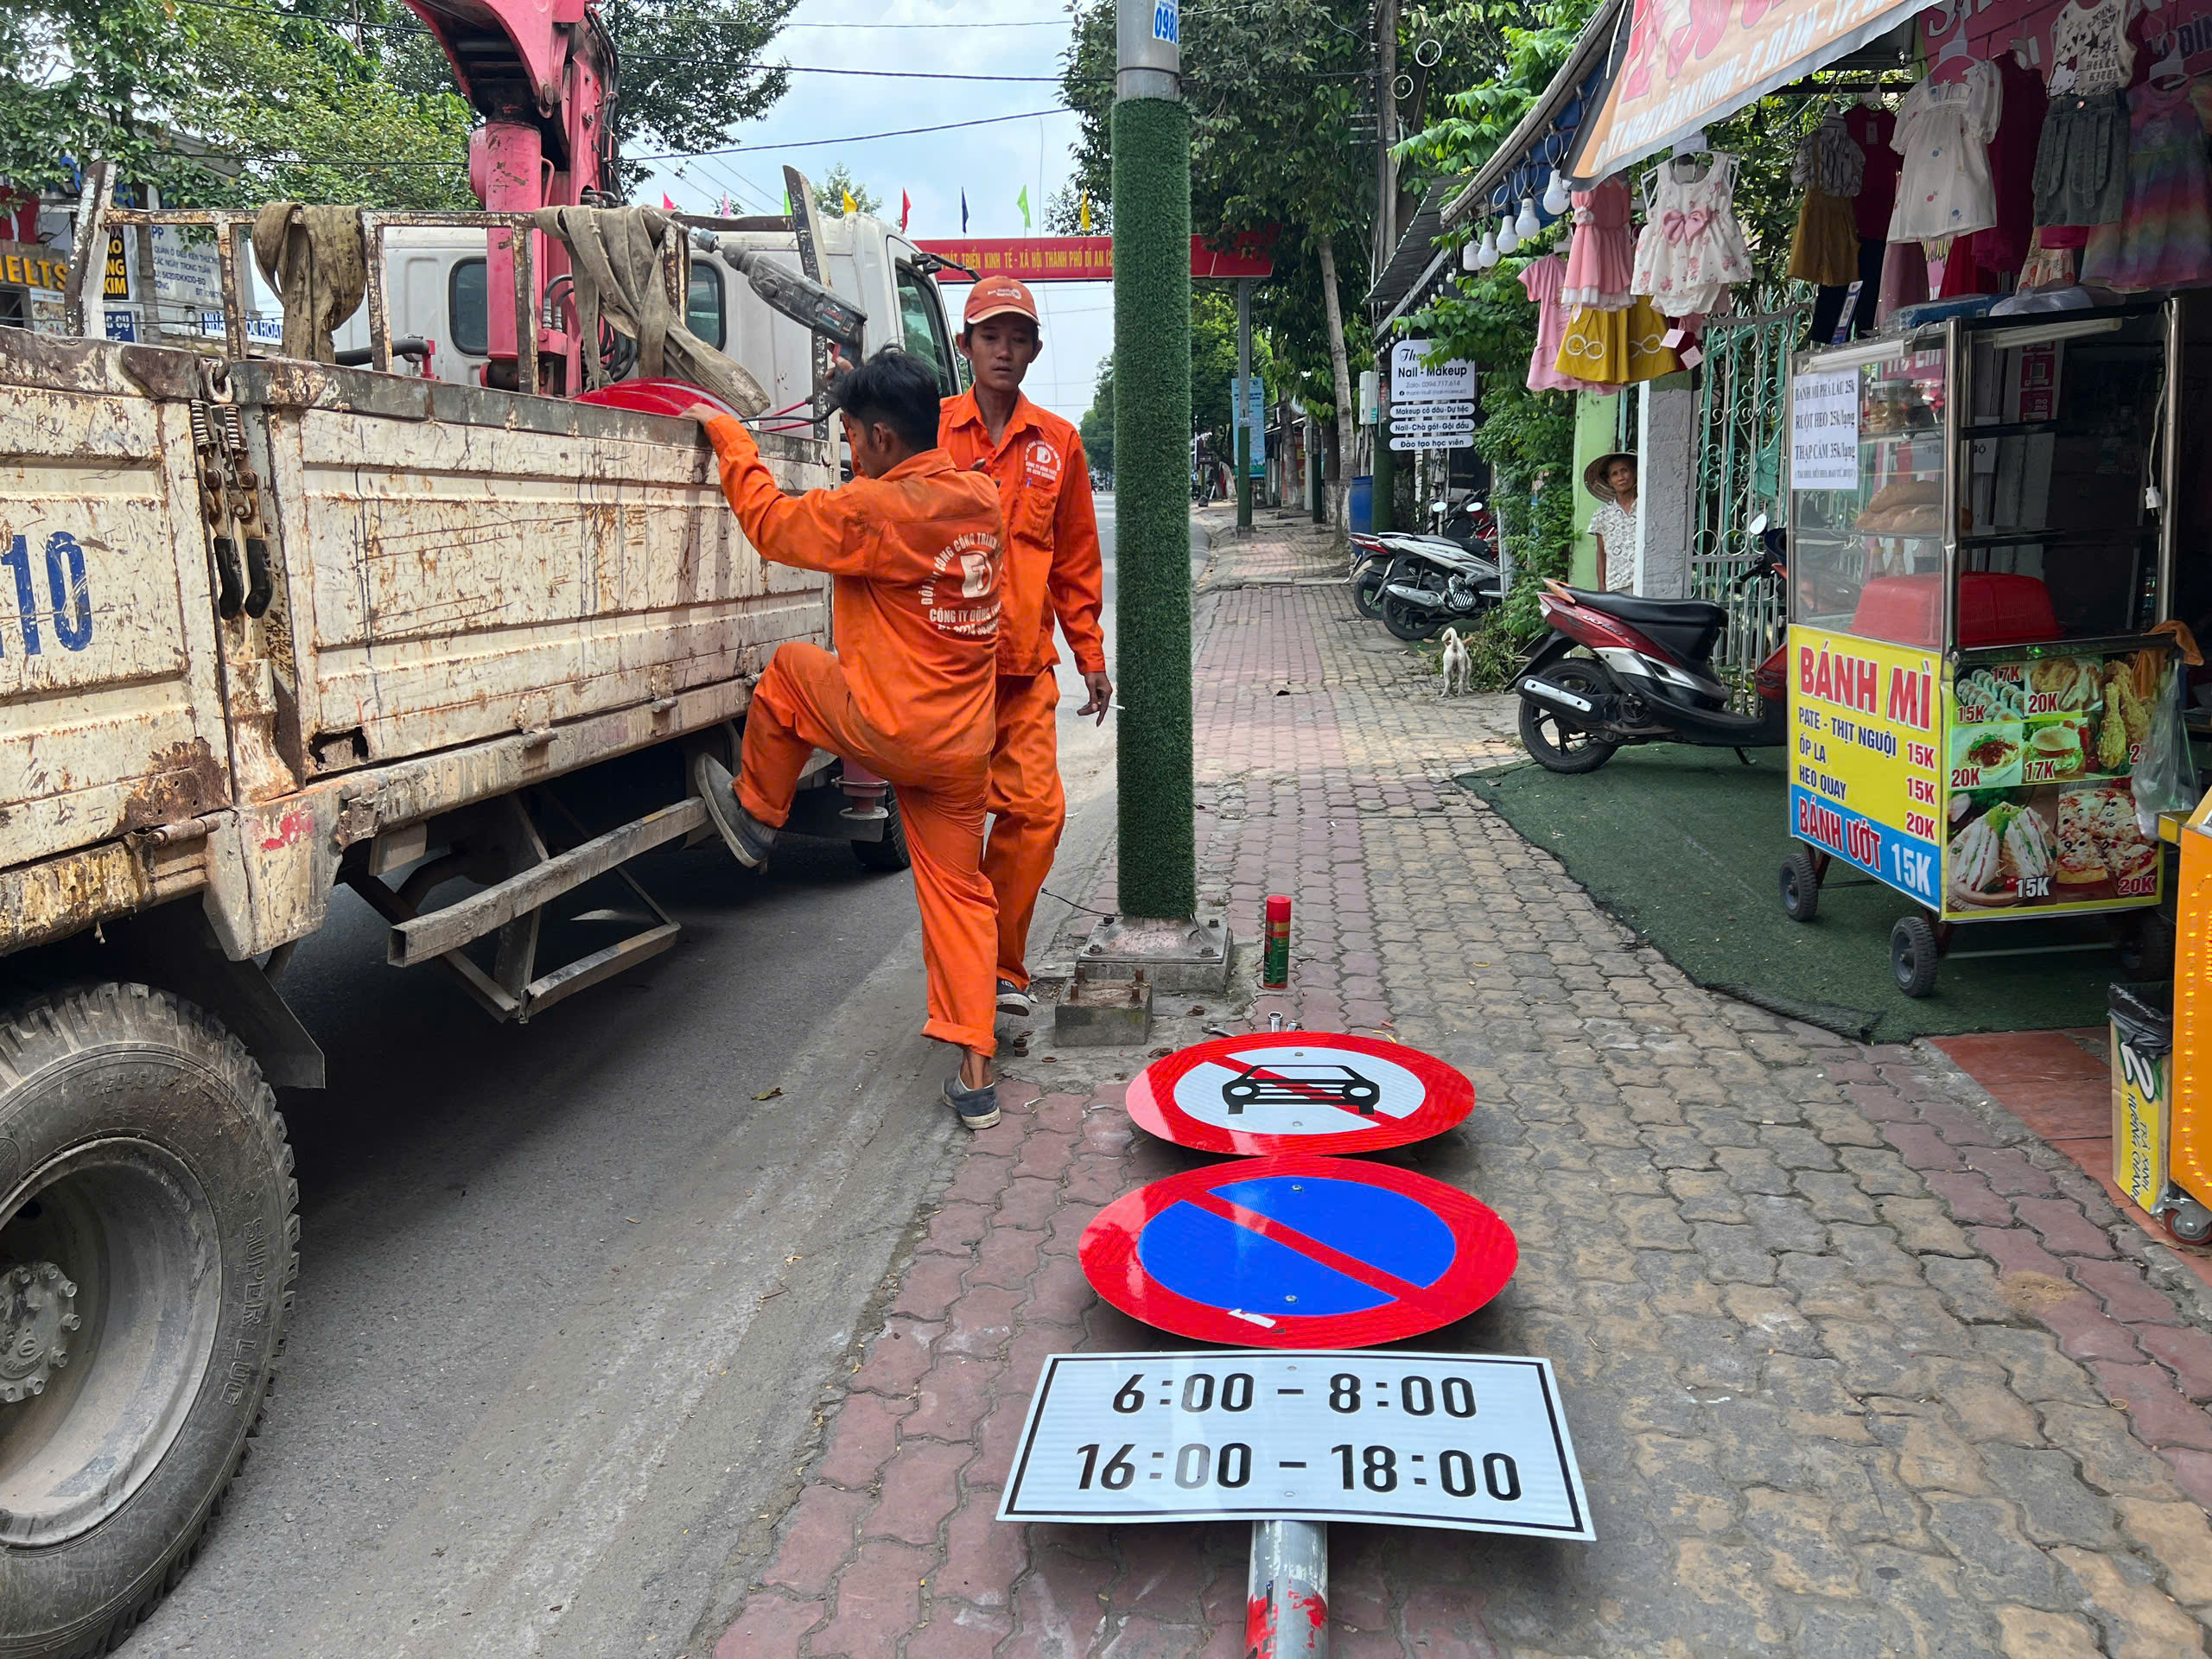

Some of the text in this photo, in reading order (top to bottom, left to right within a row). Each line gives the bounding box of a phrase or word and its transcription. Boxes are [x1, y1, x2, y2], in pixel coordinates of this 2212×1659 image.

[962, 245, 982, 270] TRIỂN
[984, 251, 1001, 270] KINH
[1004, 246, 1014, 270] TẾ
[1020, 248, 1029, 269] XÃ
[1032, 248, 1042, 272] HỘI
[1045, 247, 1067, 268] THÀNH
[1070, 245, 1083, 268] PHỐ
[1094, 250, 1104, 267] AN
[1398, 367, 1418, 378] Nail
[1427, 366, 1467, 378] Makeup
[1796, 383, 1810, 401] BÁNH
[1796, 411, 1814, 432] RUỘT
[1815, 411, 1827, 428] HEO
[1401, 440, 1415, 448] Đào
[1433, 439, 1446, 448] học
[1795, 442, 1813, 463] THẬP
[953, 532, 976, 552] CÔNG
[0, 531, 93, 655] 10
[929, 607, 956, 623] CÔNG
[958, 610, 968, 622] TY
[1991, 664, 2022, 683] 17K
[1800, 640, 1932, 731] BÁNH MÌ
[1958, 704, 1986, 723] 15K
[2028, 692, 2060, 714] 20K
[1799, 706, 1821, 730] PATE
[1831, 716, 1855, 745] THỊT
[1858, 725, 1897, 759] NGUỘI
[1799, 732, 1827, 764] ỐP LA
[1906, 741, 1936, 770] 15K
[1799, 764, 1847, 801] HEO QUAY
[1951, 767, 1982, 788] 20K
[2024, 760, 2056, 782] 17K
[1906, 777, 1936, 805] 15K
[1906, 811, 1936, 842] 20K
[1799, 795, 1933, 898] BÁNH ƯỚT 15K
[2015, 876, 2050, 899] 15K
[2118, 875, 2156, 896] 20K
[2142, 1153, 2151, 1192] XANH
[1112, 1373, 1254, 1414] 6:00
[1329, 1373, 1478, 1419] 8:00
[1076, 1442, 1252, 1491] 16:00
[1331, 1444, 1522, 1502] 18:00
